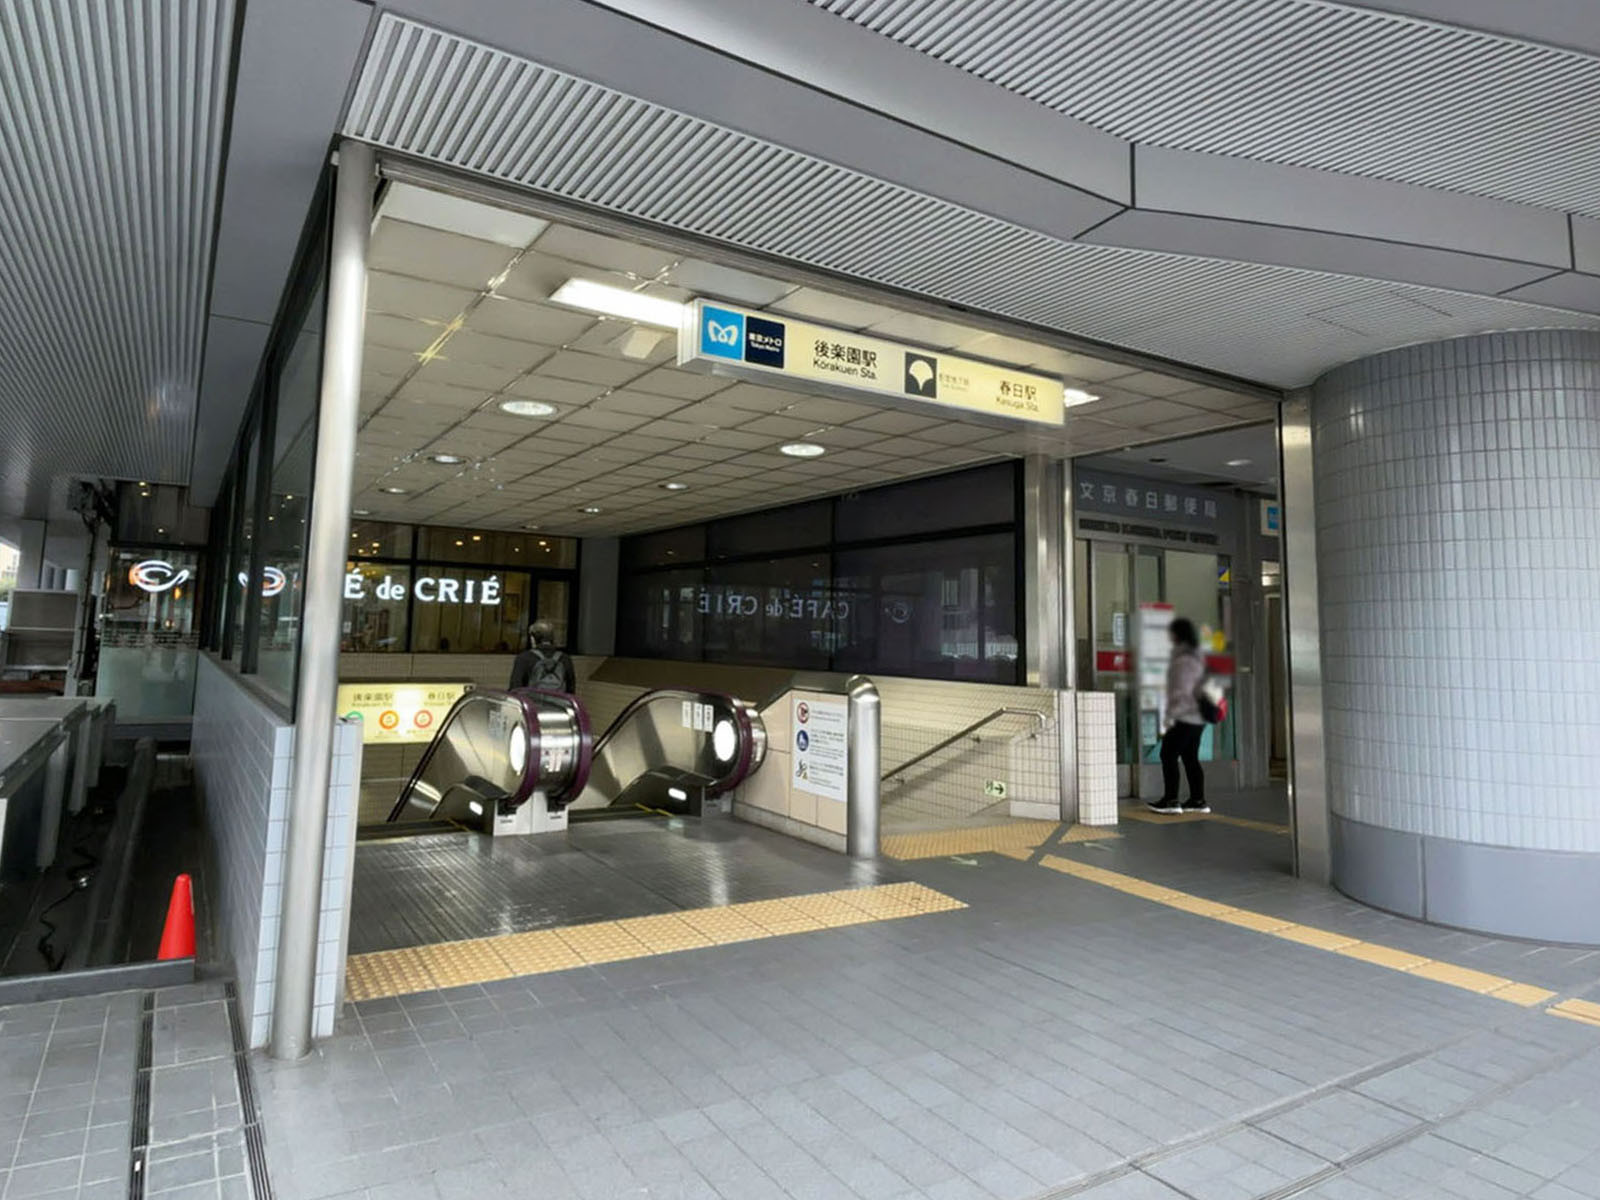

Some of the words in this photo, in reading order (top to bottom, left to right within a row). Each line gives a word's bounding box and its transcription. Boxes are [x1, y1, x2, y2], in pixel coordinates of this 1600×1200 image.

[814, 339, 878, 369] 後楽園駅
[1000, 380, 1037, 401] 春日駅
[375, 575, 406, 600] de
[414, 575, 501, 605] CRIÉ
